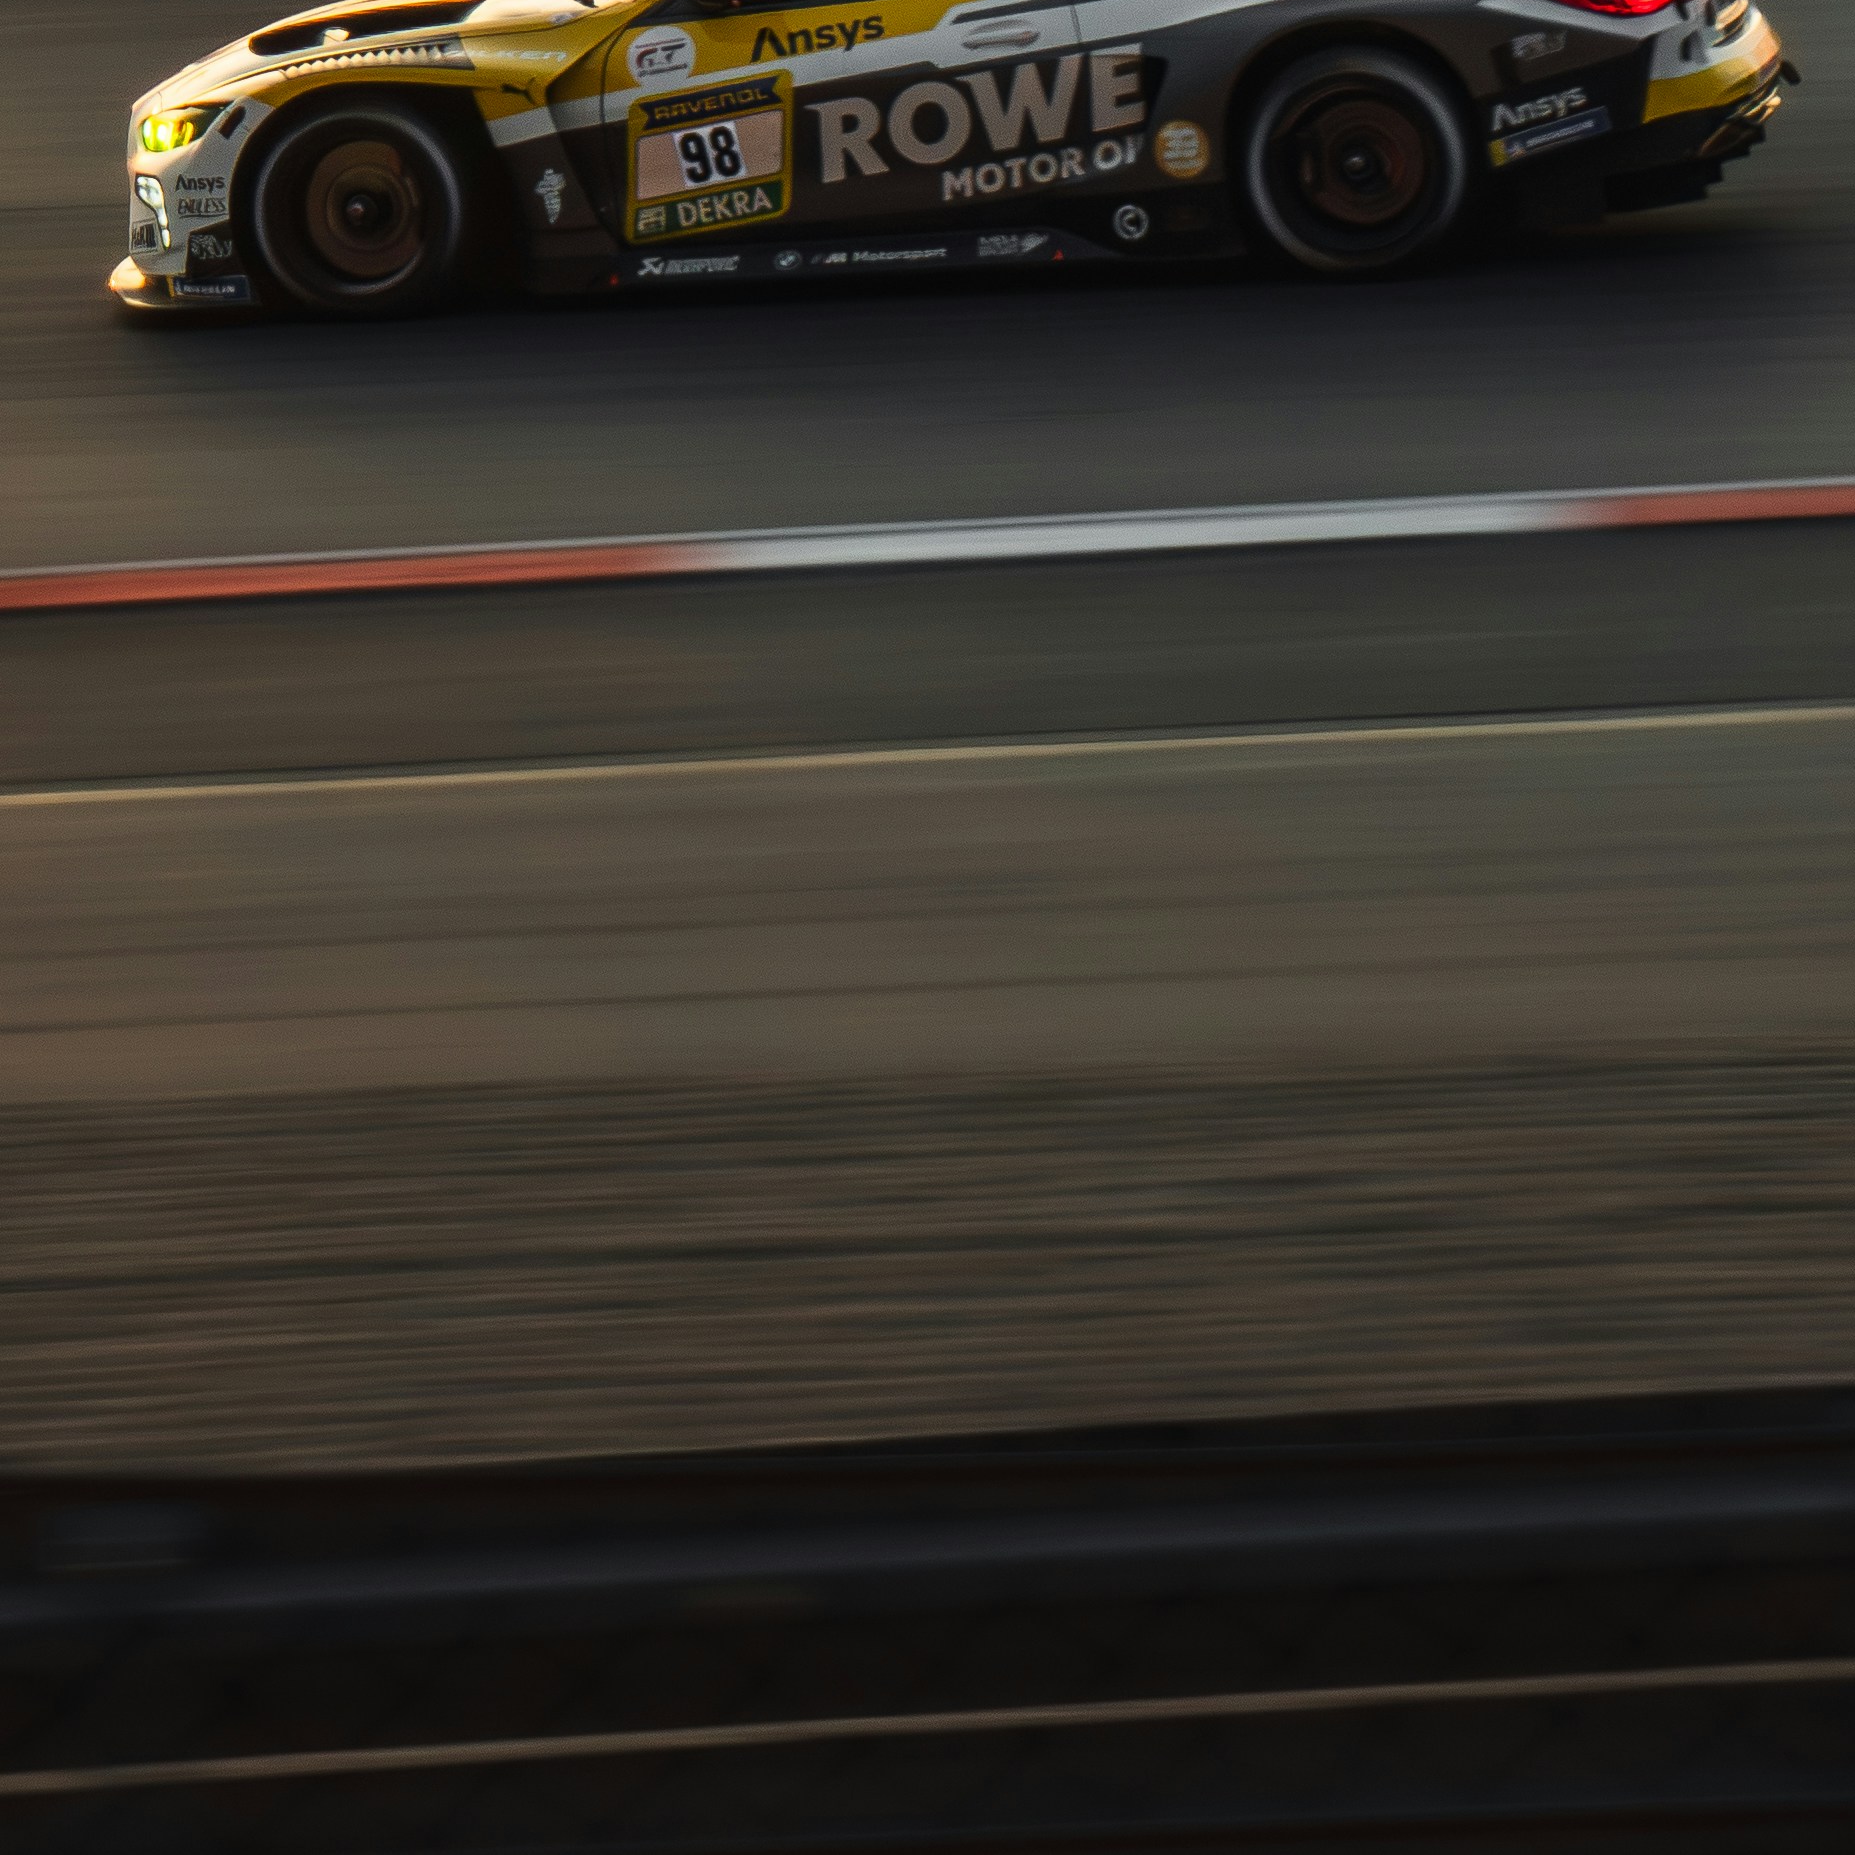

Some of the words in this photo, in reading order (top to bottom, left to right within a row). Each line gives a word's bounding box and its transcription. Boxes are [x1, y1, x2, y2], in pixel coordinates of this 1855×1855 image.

[750, 15, 885, 63] Ansys
[653, 88, 769, 120] RAVENOL
[804, 43, 1145, 184] ROWE
[1492, 87, 1587, 131] Ansys
[679, 125, 741, 183] 98
[942, 147, 1086, 202] MOTOR
[176, 174, 225, 193] Ansys
[676, 186, 772, 227] DEKRA
